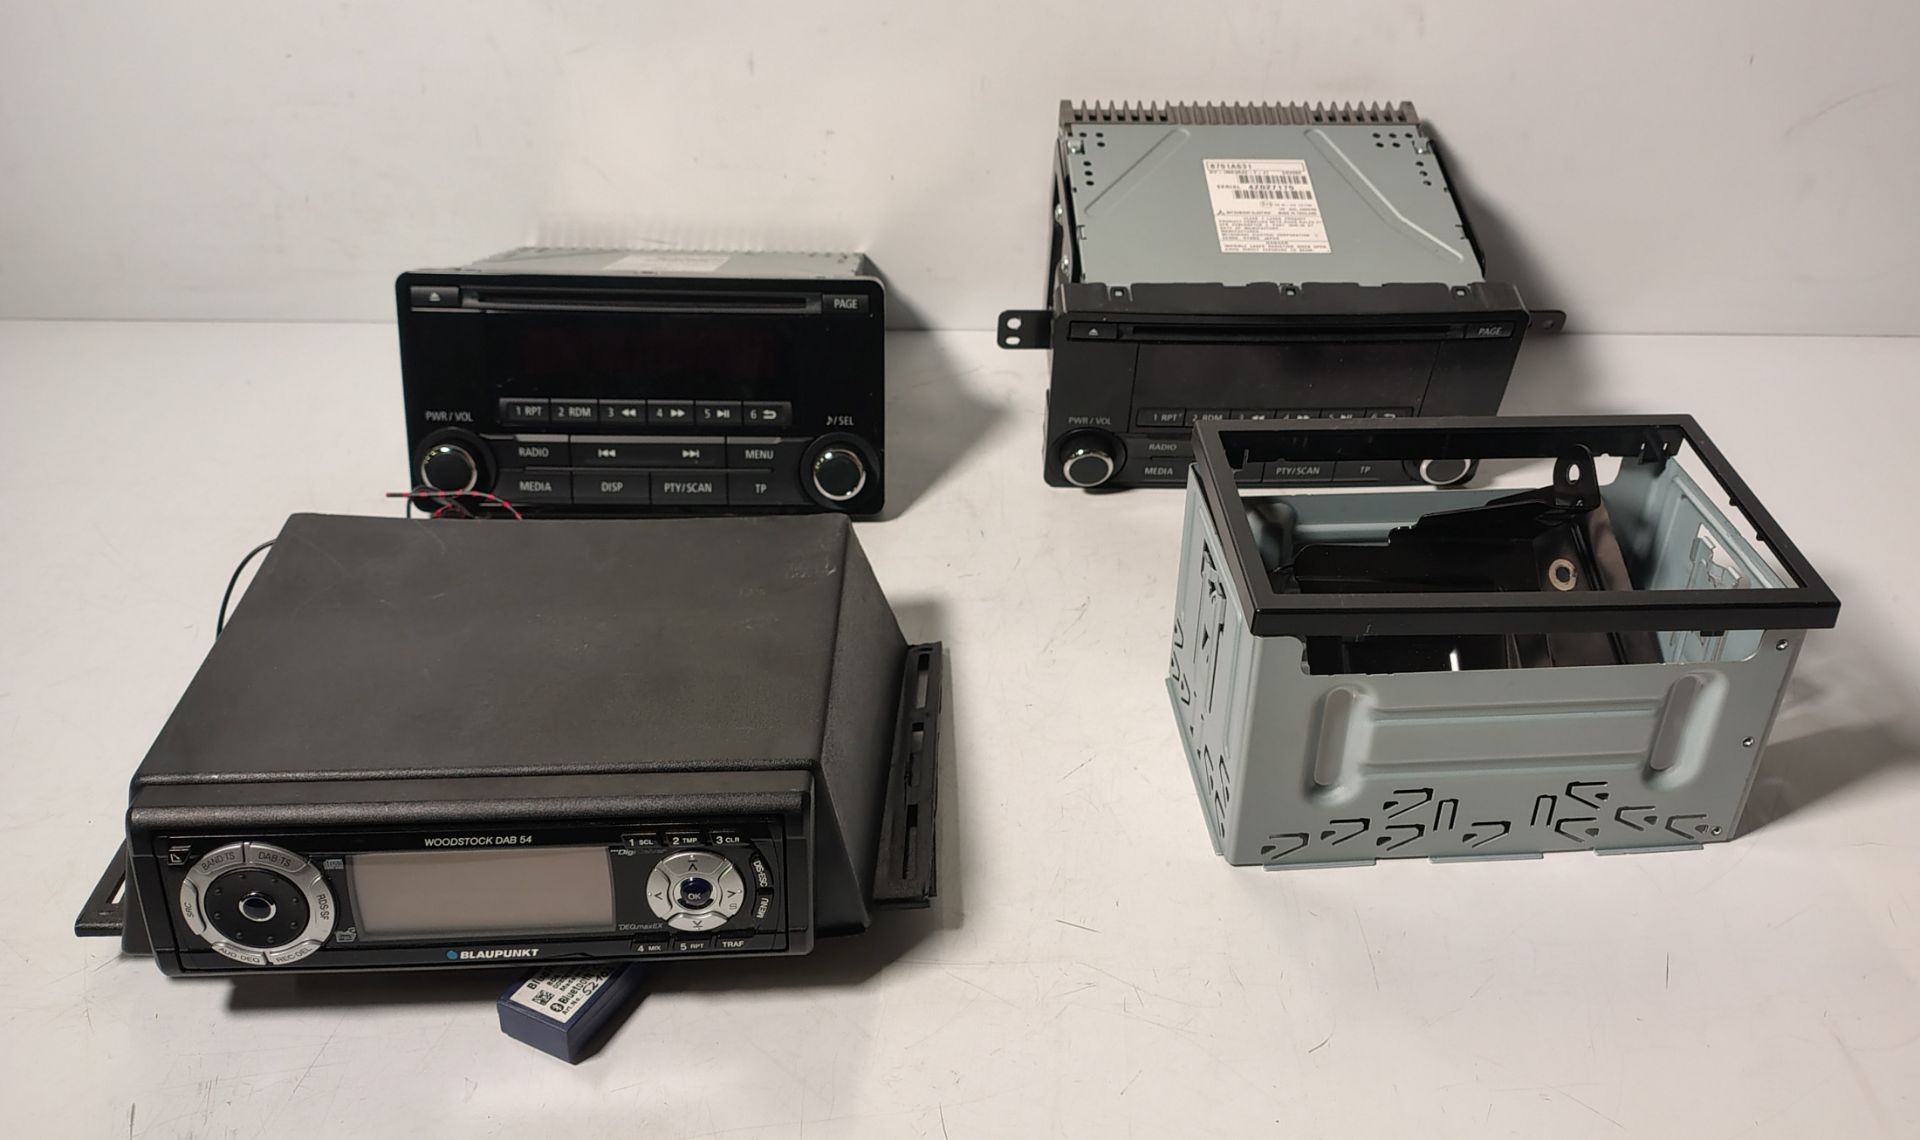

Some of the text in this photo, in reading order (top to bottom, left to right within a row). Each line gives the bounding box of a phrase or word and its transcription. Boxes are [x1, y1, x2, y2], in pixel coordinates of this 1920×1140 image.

[833, 299, 858, 309] PAGE
[1478, 327, 1503, 336] PAGE
[425, 410, 447, 422] PWR
[453, 411, 474, 423] VOL
[515, 406, 542, 417] 1 RPT
[557, 407, 592, 417] 2 RDM
[607, 408, 615, 418] 3
[656, 408, 664, 418] 4
[704, 409, 712, 419] 5
[750, 409, 757, 419] 6
[1068, 416, 1088, 426] PWR
[1094, 416, 1112, 426] VOL
[1161, 413, 1177, 423] RPT
[518, 447, 549, 458] RADIO
[1148, 443, 1177, 452] RADIO
[745, 449, 774, 460] MENU
[1144, 466, 1174, 476] MEDIA
[1275, 466, 1320, 476] PTY/SCAN
[1359, 465, 1371, 474] TP
[519, 481, 552, 492] MEDIA
[601, 481, 623, 492] DISP
[664, 482, 712, 493] PTY/SCAN
[755, 484, 767, 494] TP
[424, 835, 533, 847] WOODSTOCK DAB 54
[628, 838, 635, 847] 1
[672, 836, 680, 845] 2
[715, 836, 740, 845] 3 CLR
[687, 892, 701, 900] OK
[184, 902, 195, 918] SRC
[756, 897, 769, 919] MENU
[679, 942, 687, 951] 5
[721, 940, 745, 948] TRAF
[459, 948, 540, 960] BLAUPUNKT
